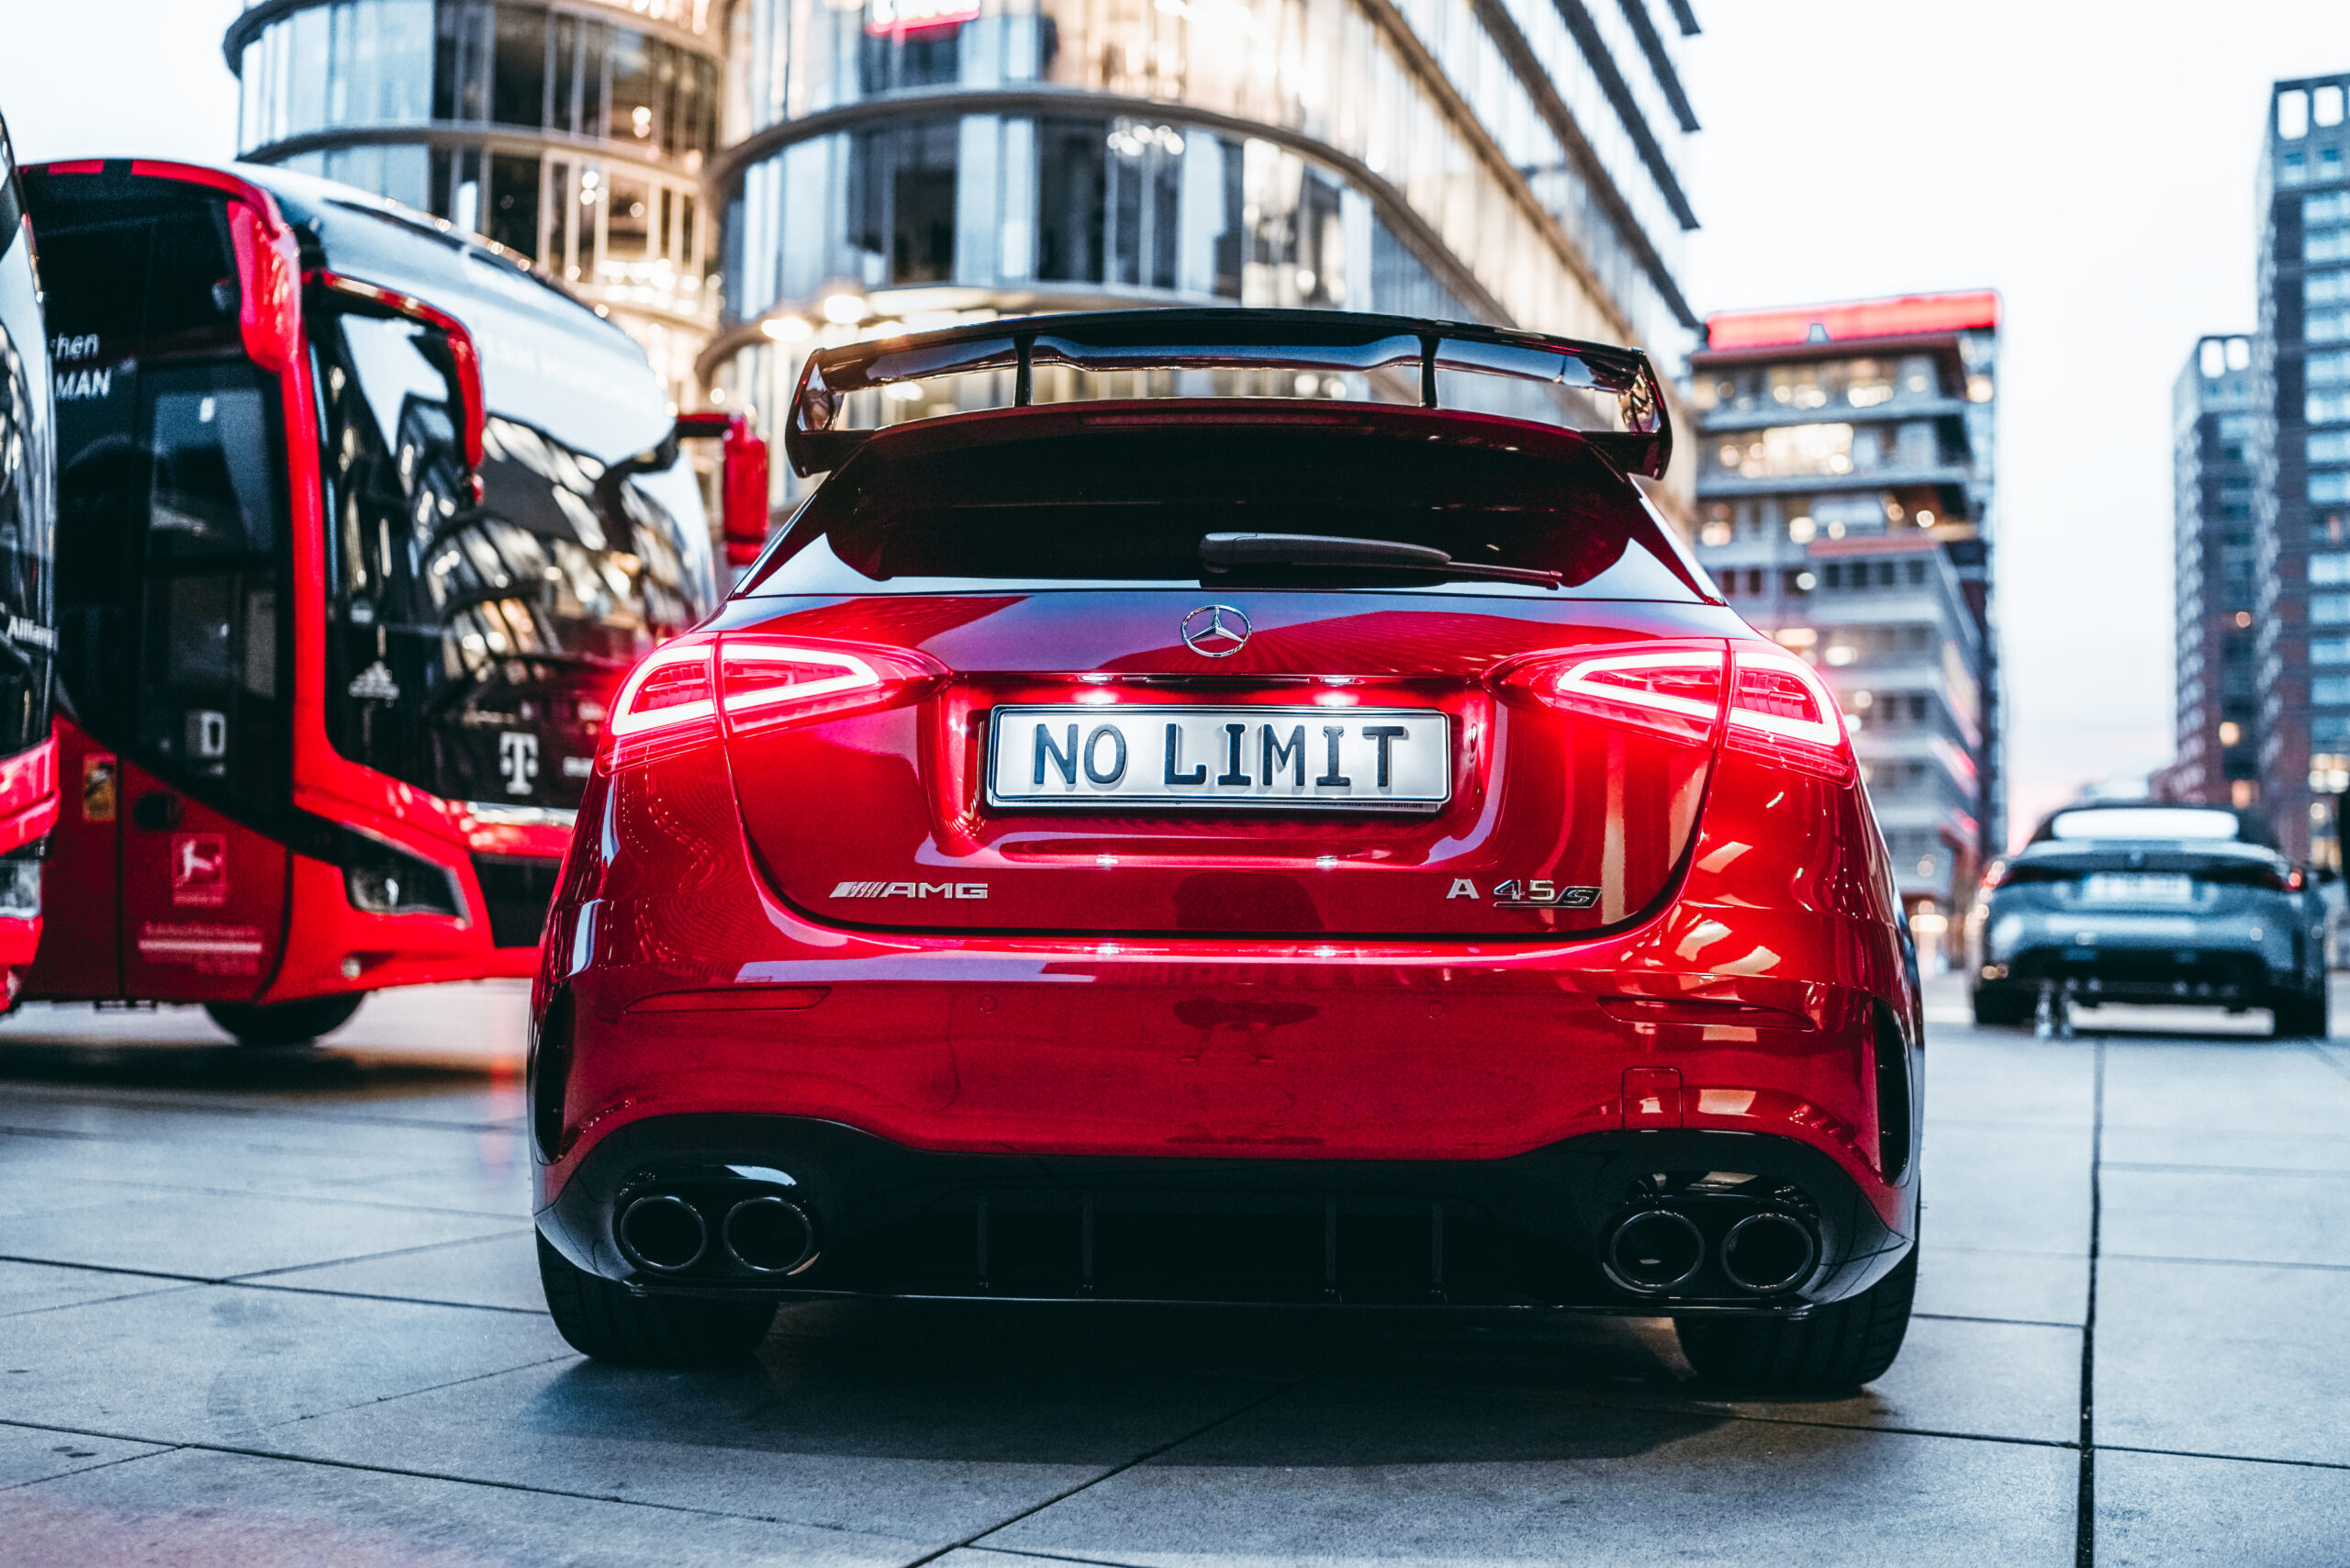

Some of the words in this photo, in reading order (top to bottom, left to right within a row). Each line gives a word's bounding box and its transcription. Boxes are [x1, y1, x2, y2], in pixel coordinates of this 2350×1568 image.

[50, 332, 100, 360] hen
[55, 368, 111, 399] MAN
[499, 732, 539, 795] T
[1034, 723, 1126, 786] NO
[1163, 722, 1404, 787] LIMIT
[879, 881, 989, 900] AMG
[1446, 878, 1480, 900] A
